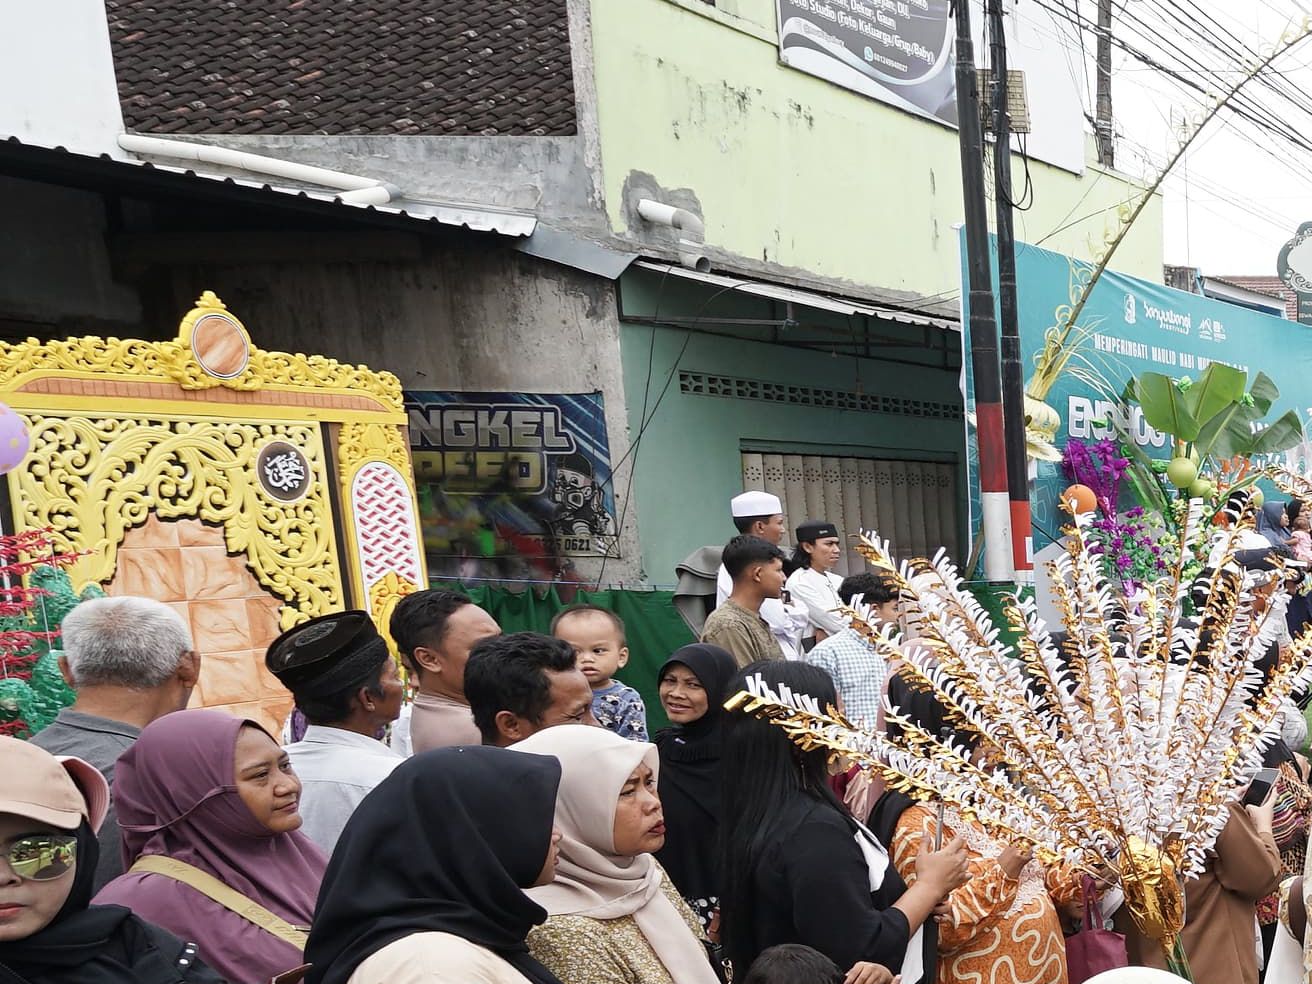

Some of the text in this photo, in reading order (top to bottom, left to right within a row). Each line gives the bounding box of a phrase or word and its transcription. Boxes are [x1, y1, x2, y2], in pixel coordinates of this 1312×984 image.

[1094, 333, 1148, 360] MEMPERINGATI
[1152, 346, 1176, 366] MAULID
[1179, 352, 1194, 369] NABI
[408, 408, 570, 448] NGKEL
[412, 450, 544, 490] PEED
[564, 538, 591, 551] 0621
